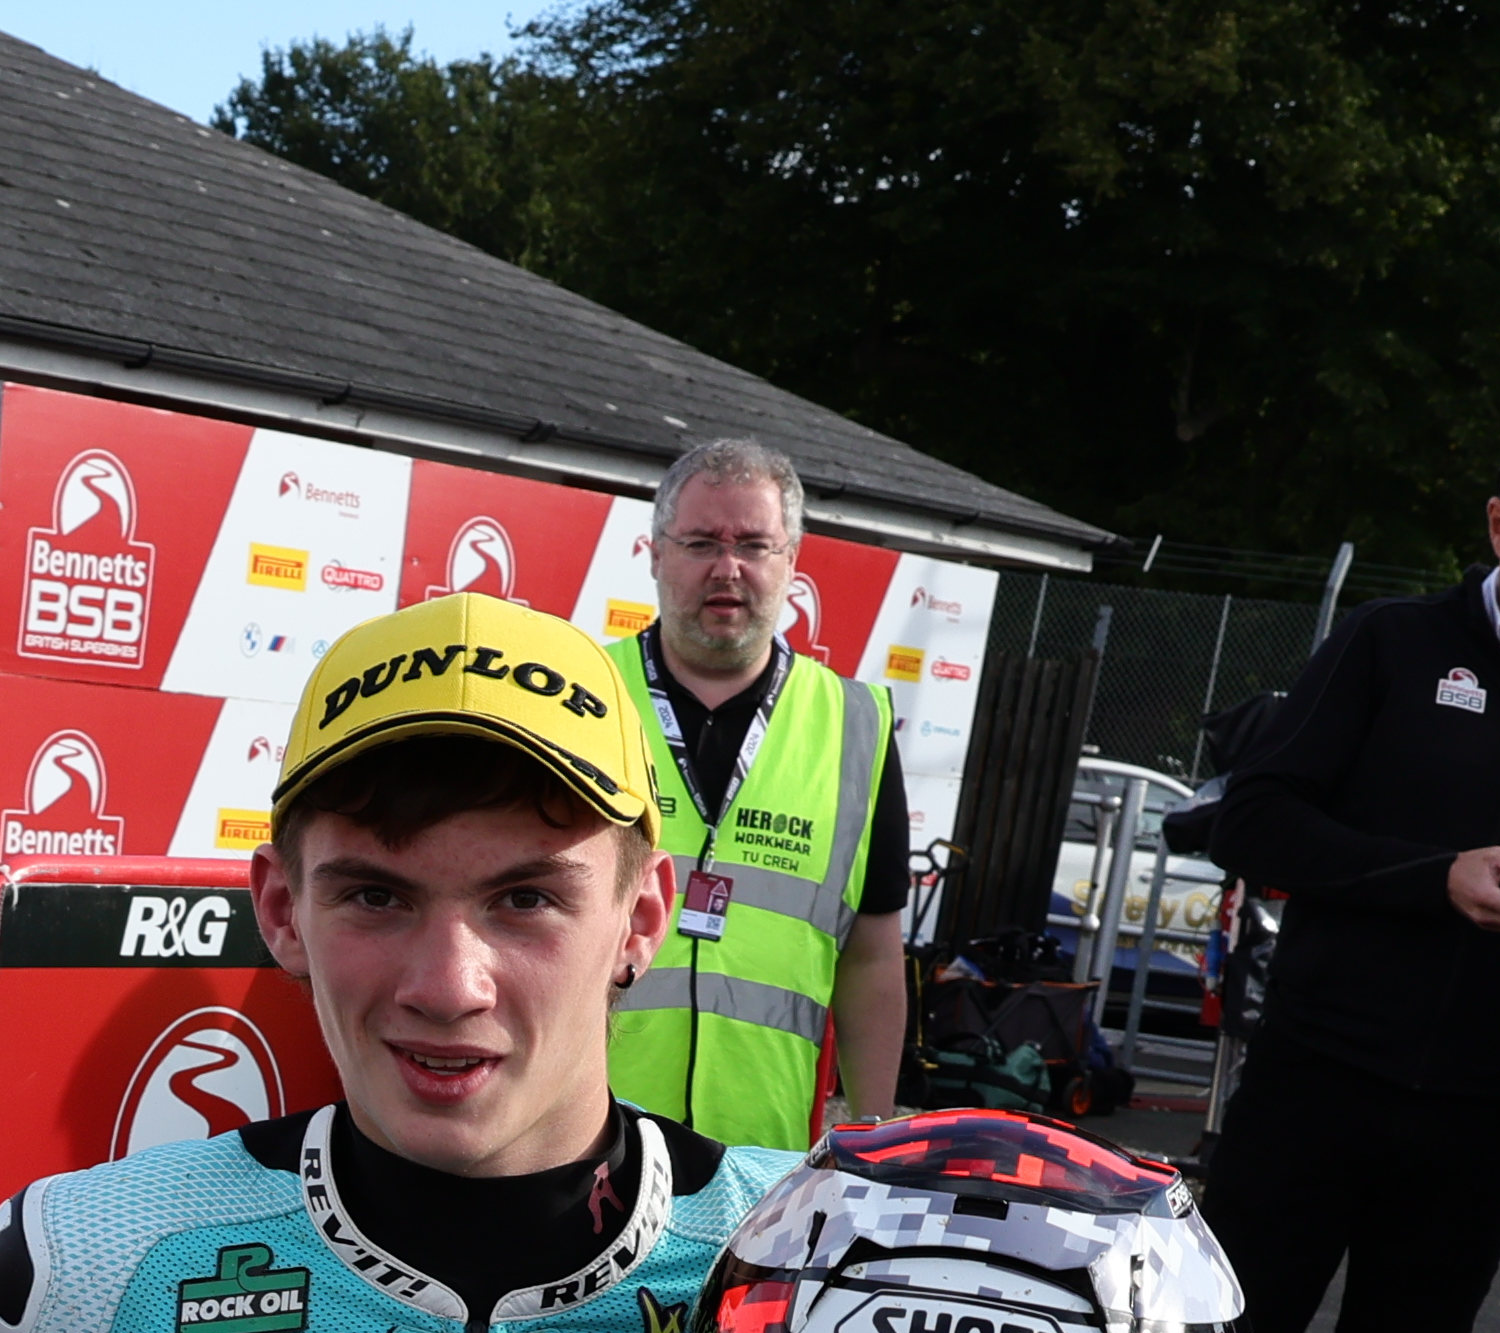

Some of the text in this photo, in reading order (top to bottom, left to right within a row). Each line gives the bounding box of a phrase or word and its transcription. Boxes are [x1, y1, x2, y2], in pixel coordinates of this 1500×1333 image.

[33, 541, 146, 588] Bennetts
[253, 554, 302, 582] PIRELLI
[324, 567, 380, 589] QUATTRO
[27, 580, 143, 642] BSB
[319, 645, 608, 729] DUNLOP
[6, 821, 115, 855] Bennetts
[734, 831, 811, 856] WORKWEAR
[741, 850, 800, 873] TV CREW
[120, 896, 229, 957] R&G
[181, 1289, 303, 1323] ROCK OIL
